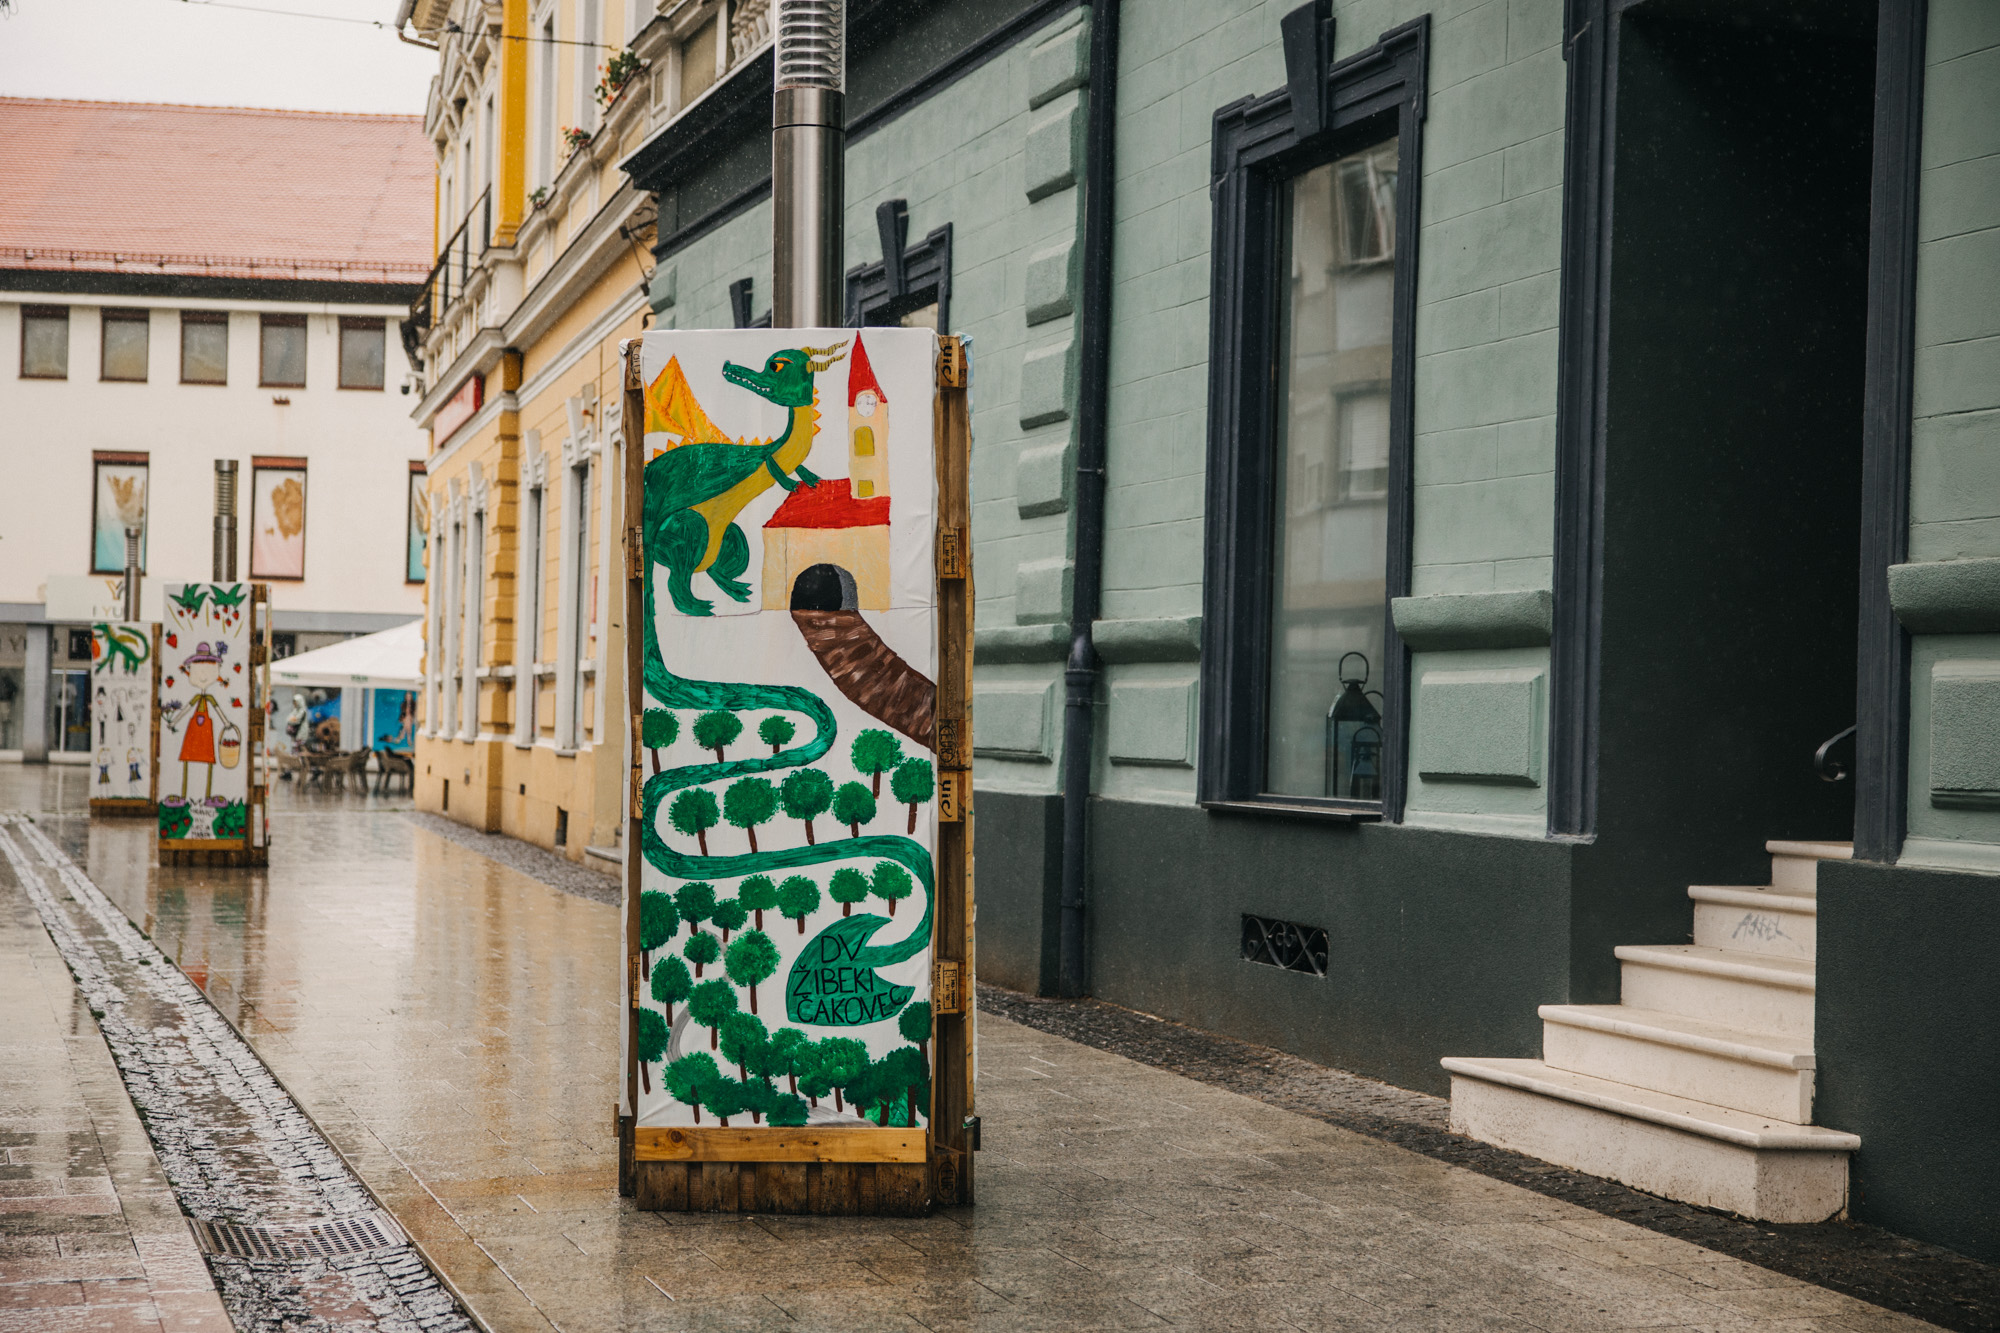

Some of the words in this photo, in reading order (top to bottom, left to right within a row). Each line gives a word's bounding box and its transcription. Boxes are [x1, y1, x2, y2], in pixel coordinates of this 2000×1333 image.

[821, 932, 867, 963] DV
[793, 964, 874, 997] ŽIBEKI
[797, 985, 907, 1025] ČAKOVEC
